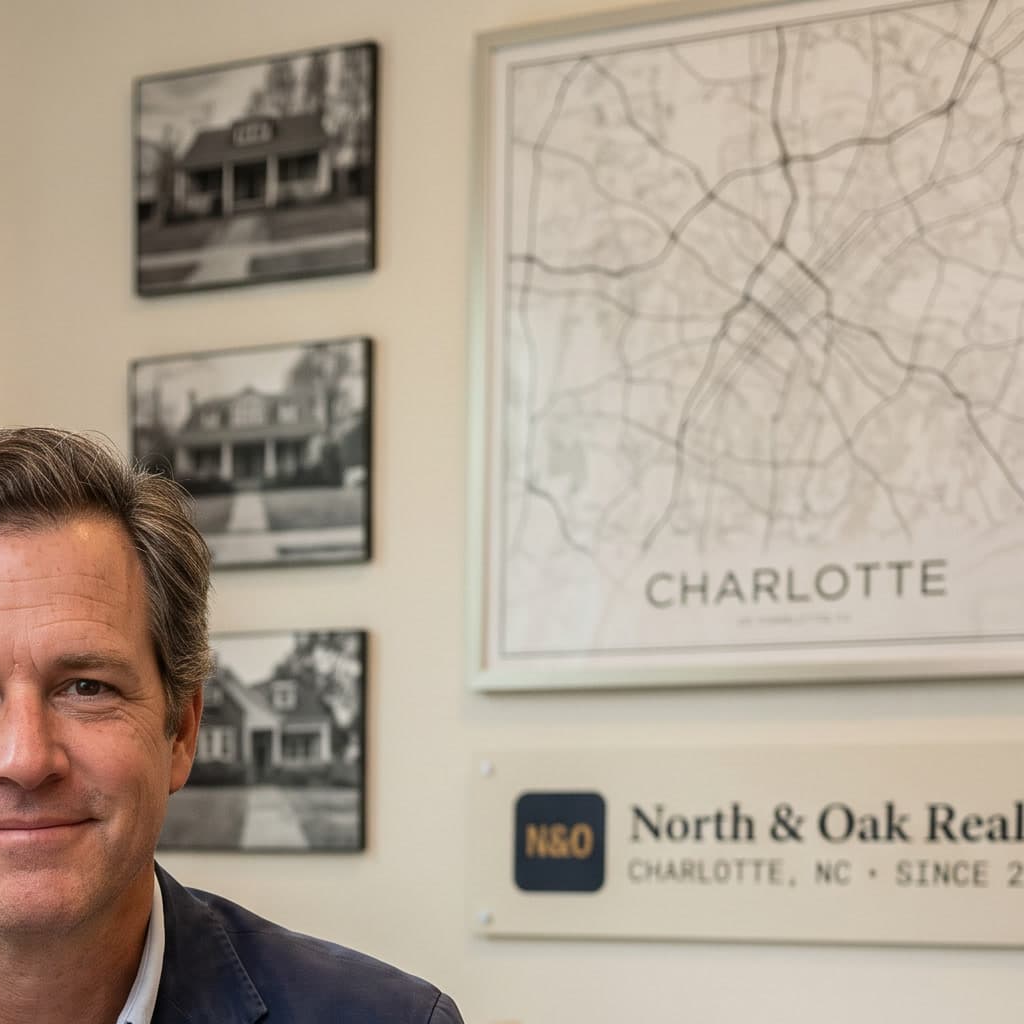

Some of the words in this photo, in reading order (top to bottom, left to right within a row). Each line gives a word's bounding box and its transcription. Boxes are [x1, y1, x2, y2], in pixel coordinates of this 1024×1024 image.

[645, 558, 948, 609] CHARLOTTE
[525, 823, 593, 859] N&O
[630, 802, 756, 842] North
[770, 802, 804, 842] &
[818, 801, 911, 843] Oak
[927, 800, 1024, 843] Real
[628, 857, 797, 888] CHARLOTTE,
[815, 859, 851, 887] NC
[895, 858, 991, 888] SINCE
